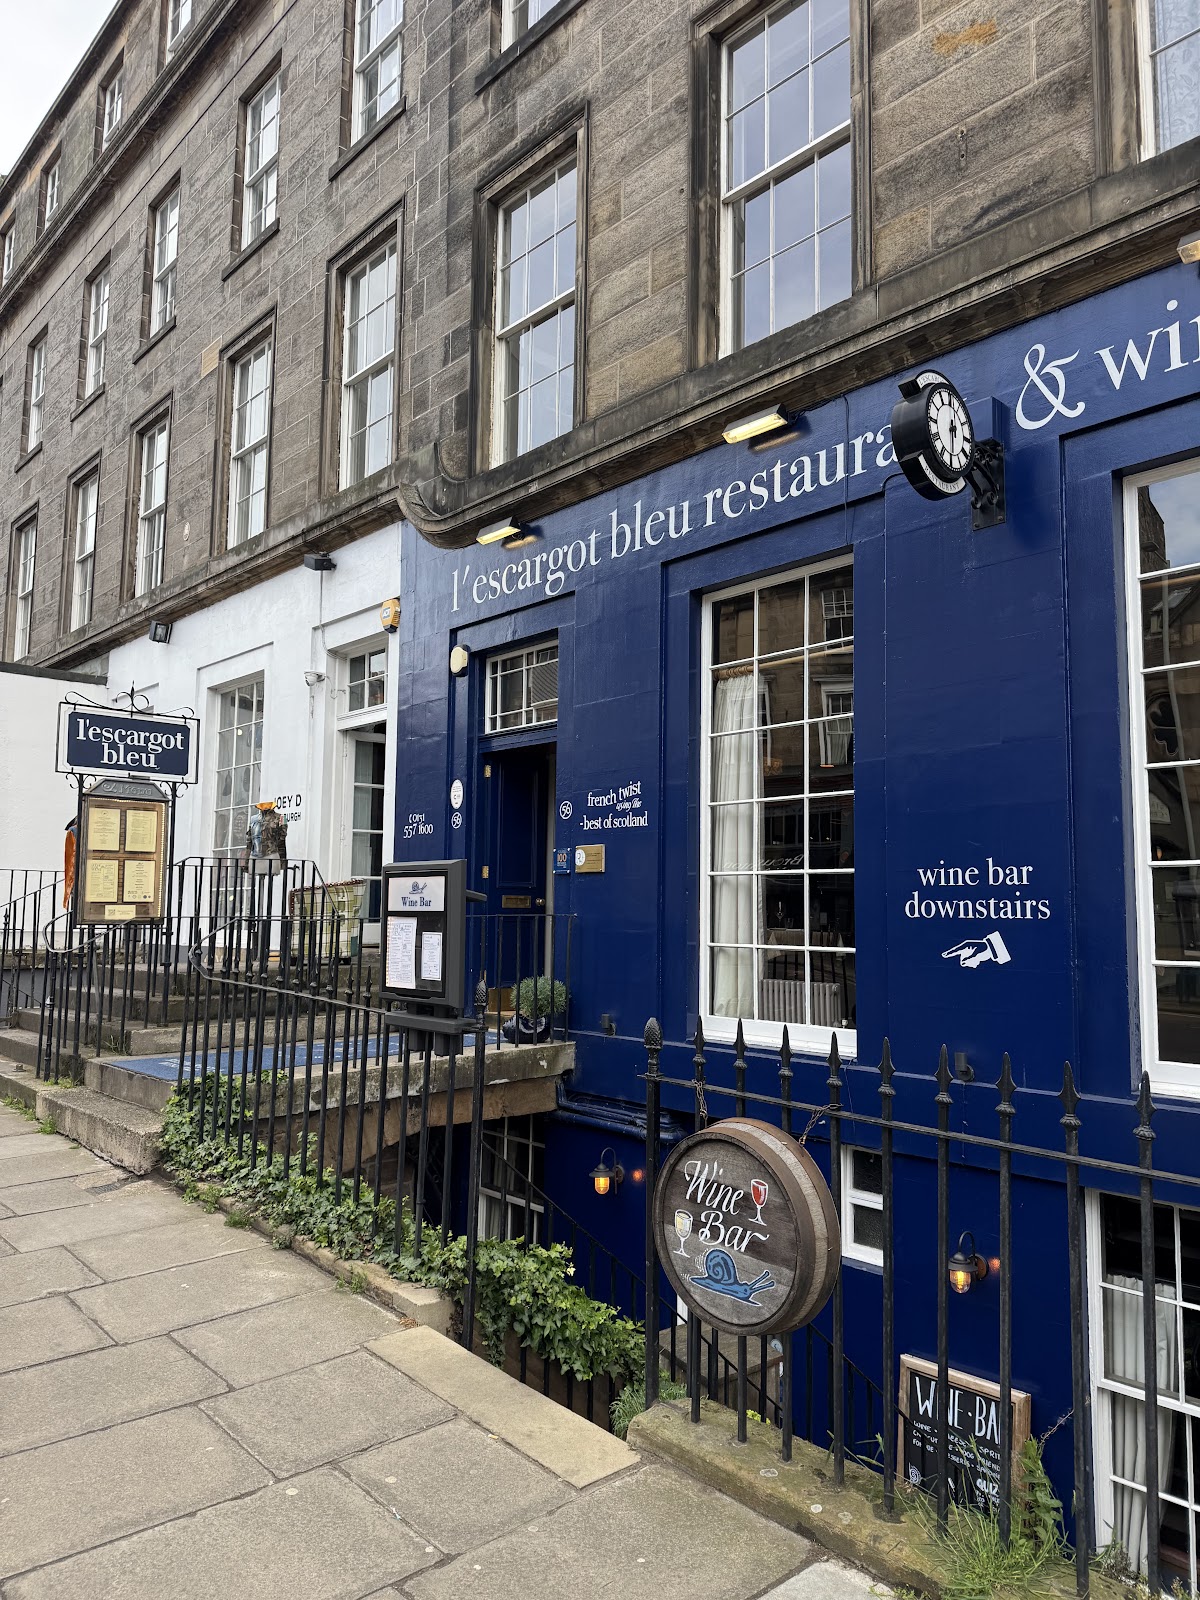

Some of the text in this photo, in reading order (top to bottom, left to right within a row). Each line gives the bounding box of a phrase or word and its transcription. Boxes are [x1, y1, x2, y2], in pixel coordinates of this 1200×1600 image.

[451, 299, 1200, 612] l'escargot bleu restaura & wi
[76, 718, 185, 754] l'escargot
[100, 743, 158, 768] bleu
[295, 794, 302, 807] D
[587, 781, 642, 807] french twist
[403, 822, 434, 839] 557 1600
[603, 813, 613, 829] of
[613, 811, 648, 829] scotland
[916, 857, 1033, 887] wine bar
[401, 896, 432, 907] Wine Bar
[904, 890, 1051, 920] downstairs
[684, 1160, 744, 1216] Wine
[698, 1210, 770, 1253] Bar
[974, 1395, 1001, 1445] BA
